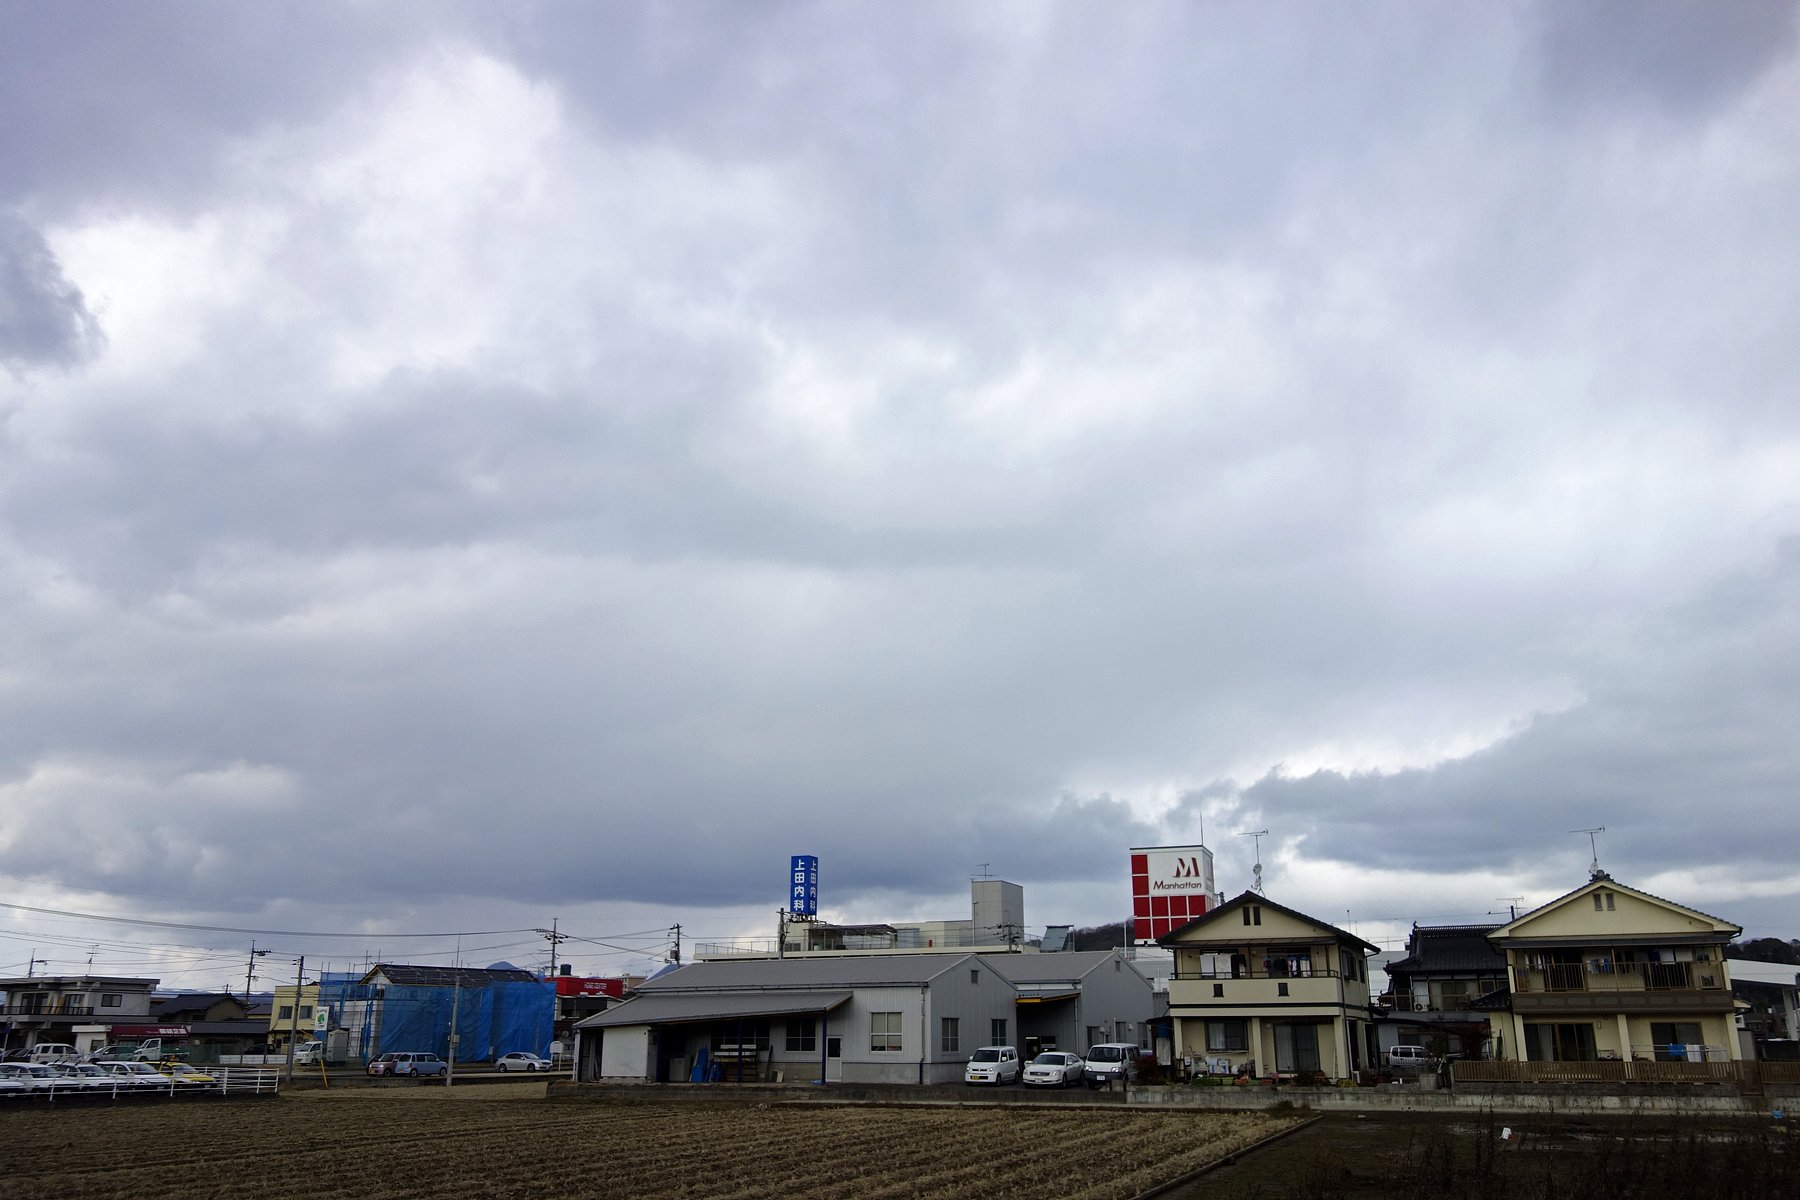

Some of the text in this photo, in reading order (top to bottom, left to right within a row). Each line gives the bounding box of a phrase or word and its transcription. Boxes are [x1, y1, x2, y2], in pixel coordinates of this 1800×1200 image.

[794, 859, 805, 911] 上田内科
[1153, 880, 1202, 890] Manhattan
